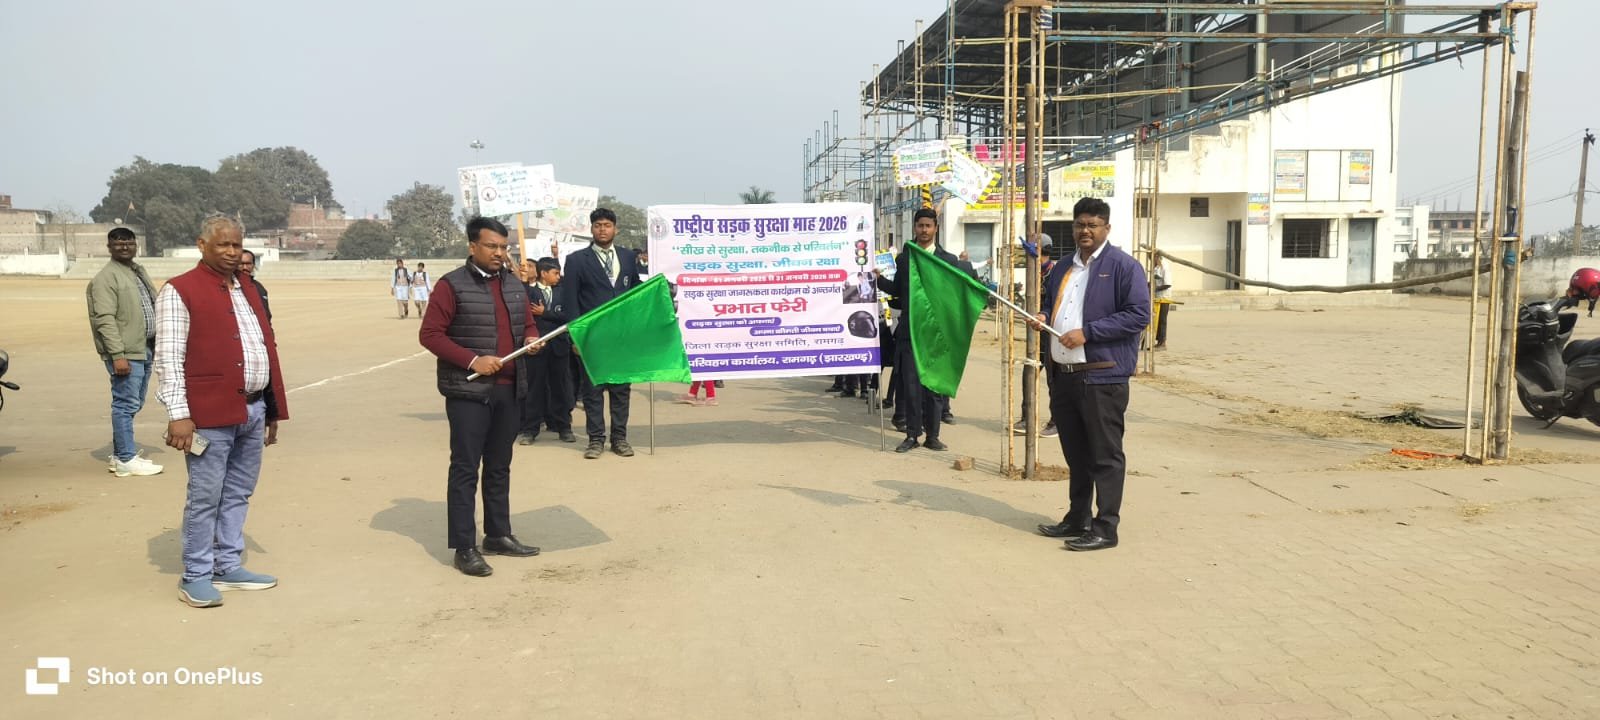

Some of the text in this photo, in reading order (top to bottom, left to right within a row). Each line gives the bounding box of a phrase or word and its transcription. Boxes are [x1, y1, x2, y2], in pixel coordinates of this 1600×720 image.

[673, 214, 847, 239] राष्ट्रीय सड़क सुरक्षा माह 2026
[706, 243, 716, 255] से
[751, 242, 790, 253] तकनीक
[793, 242, 802, 252] से
[683, 261, 722, 272] सड़क
[771, 257, 812, 268] जीवन
[815, 258, 840, 266] रक्षा
[785, 273, 809, 281] जनवरी
[683, 290, 705, 300] सड़क
[706, 289, 727, 301] सुरक्षा
[770, 285, 801, 296] कार्यक्रम
[802, 285, 811, 295] के
[811, 284, 841, 295] अन्तर्गत
[712, 297, 809, 317] प्रभात फेरी
[685, 341, 711, 350] जिला
[714, 342, 742, 351] सड़क
[744, 341, 772, 350] सुरक्षा
[688, 357, 729, 368] परिवहन
[781, 355, 817, 365] रामगढ़
